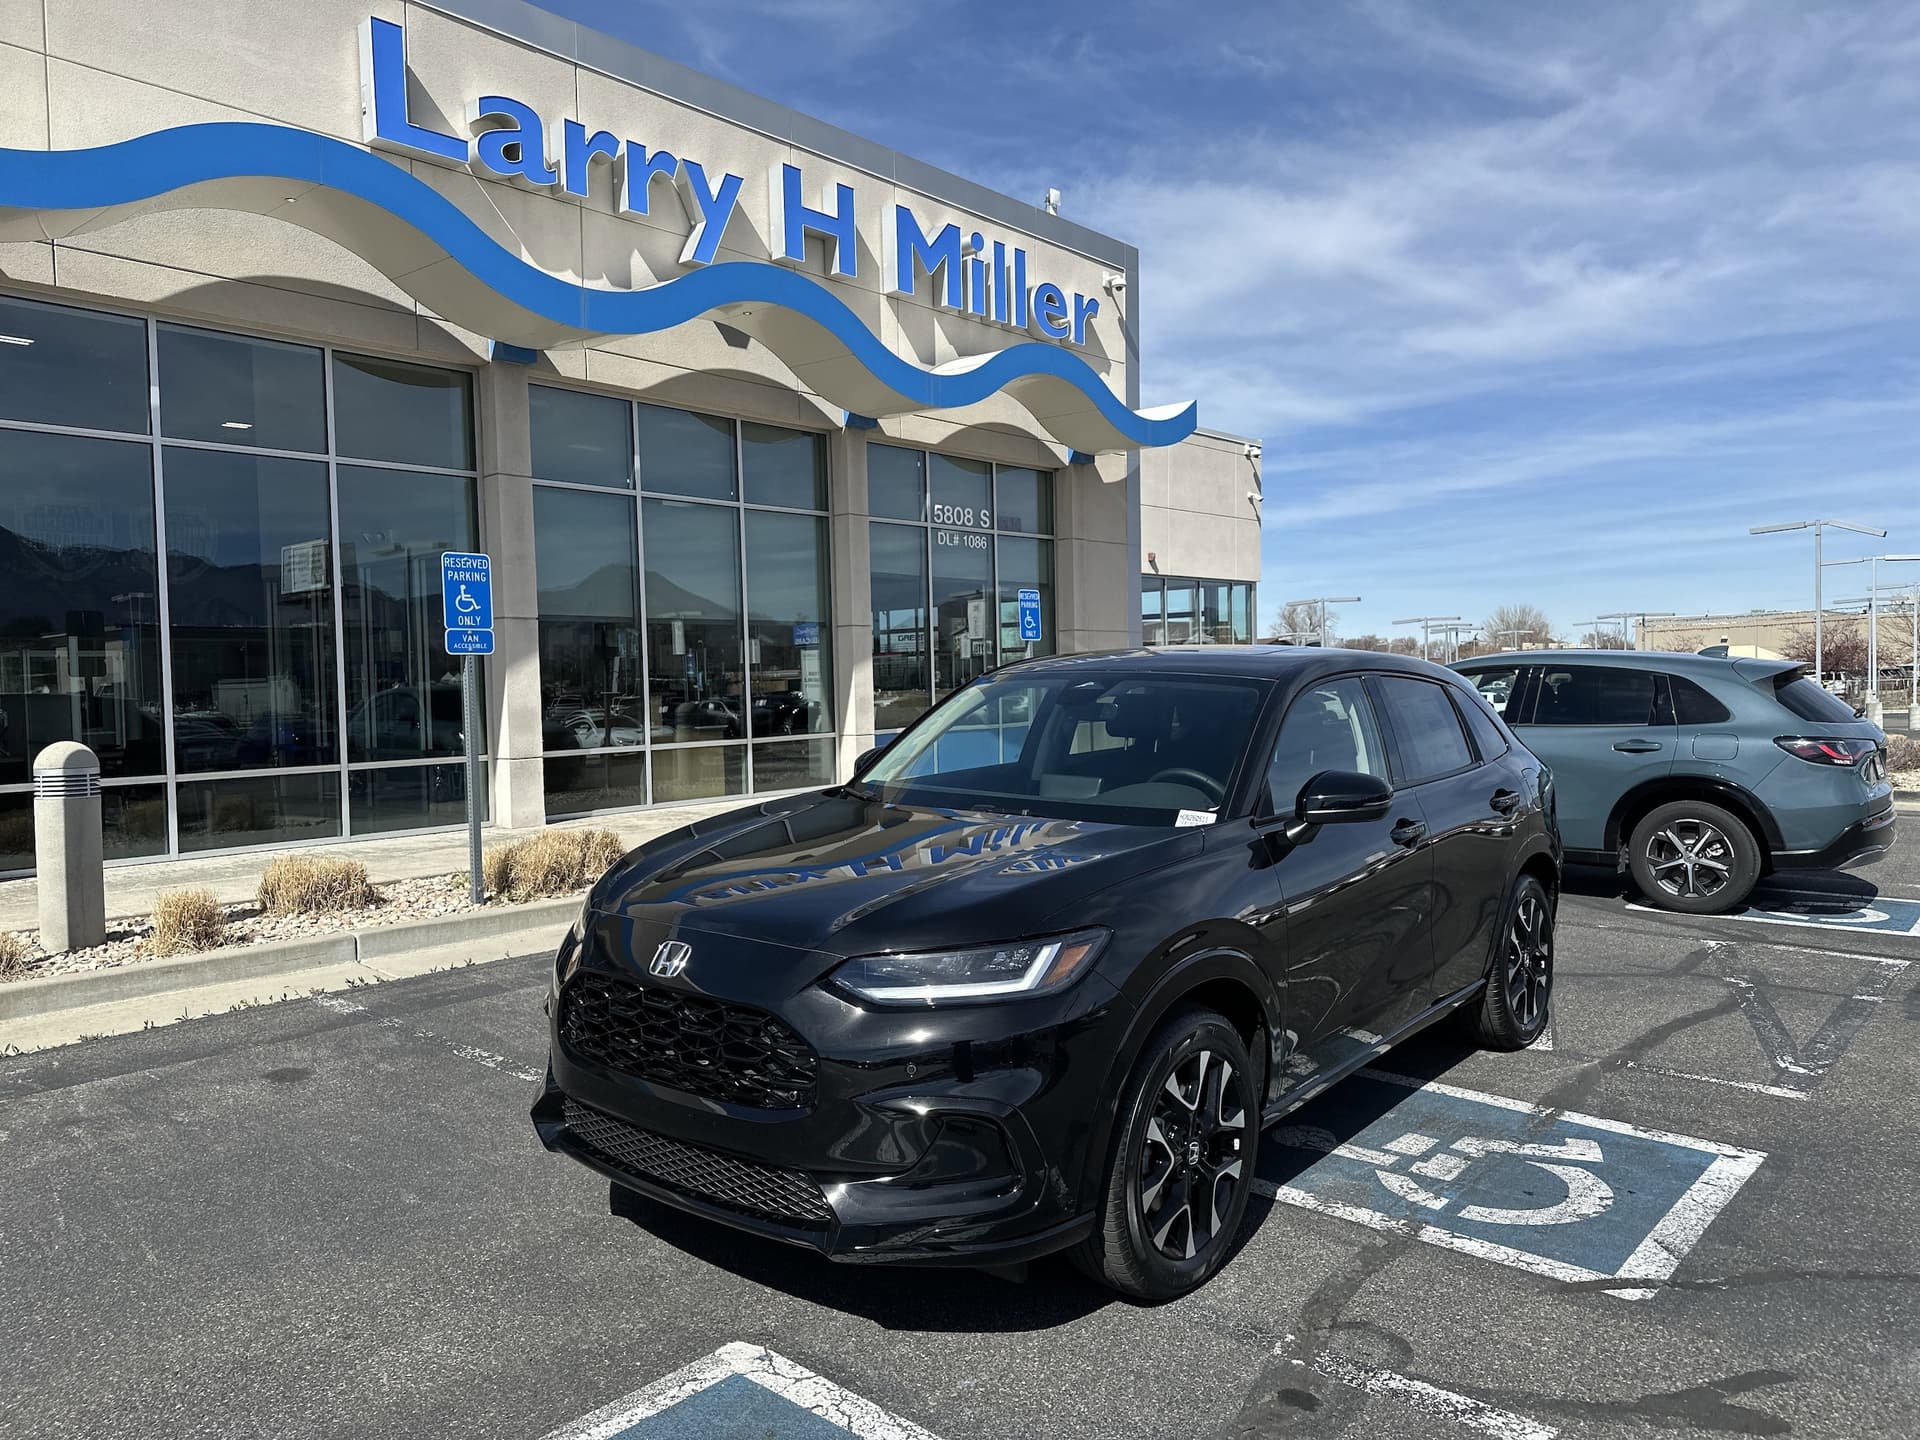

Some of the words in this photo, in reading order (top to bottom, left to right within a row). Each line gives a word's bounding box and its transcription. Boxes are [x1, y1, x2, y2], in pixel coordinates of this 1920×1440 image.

[366, 14, 744, 266] Larry
[773, 162, 858, 278] H
[889, 204, 1101, 345] Miller
[933, 504, 974, 526] 5808
[979, 509, 990, 528] S
[937, 532, 959, 545] DL#
[963, 535, 987, 549] 1086
[444, 557, 488, 569] RESERVED
[447, 571, 487, 582] PARKING
[458, 616, 481, 625] ONLY
